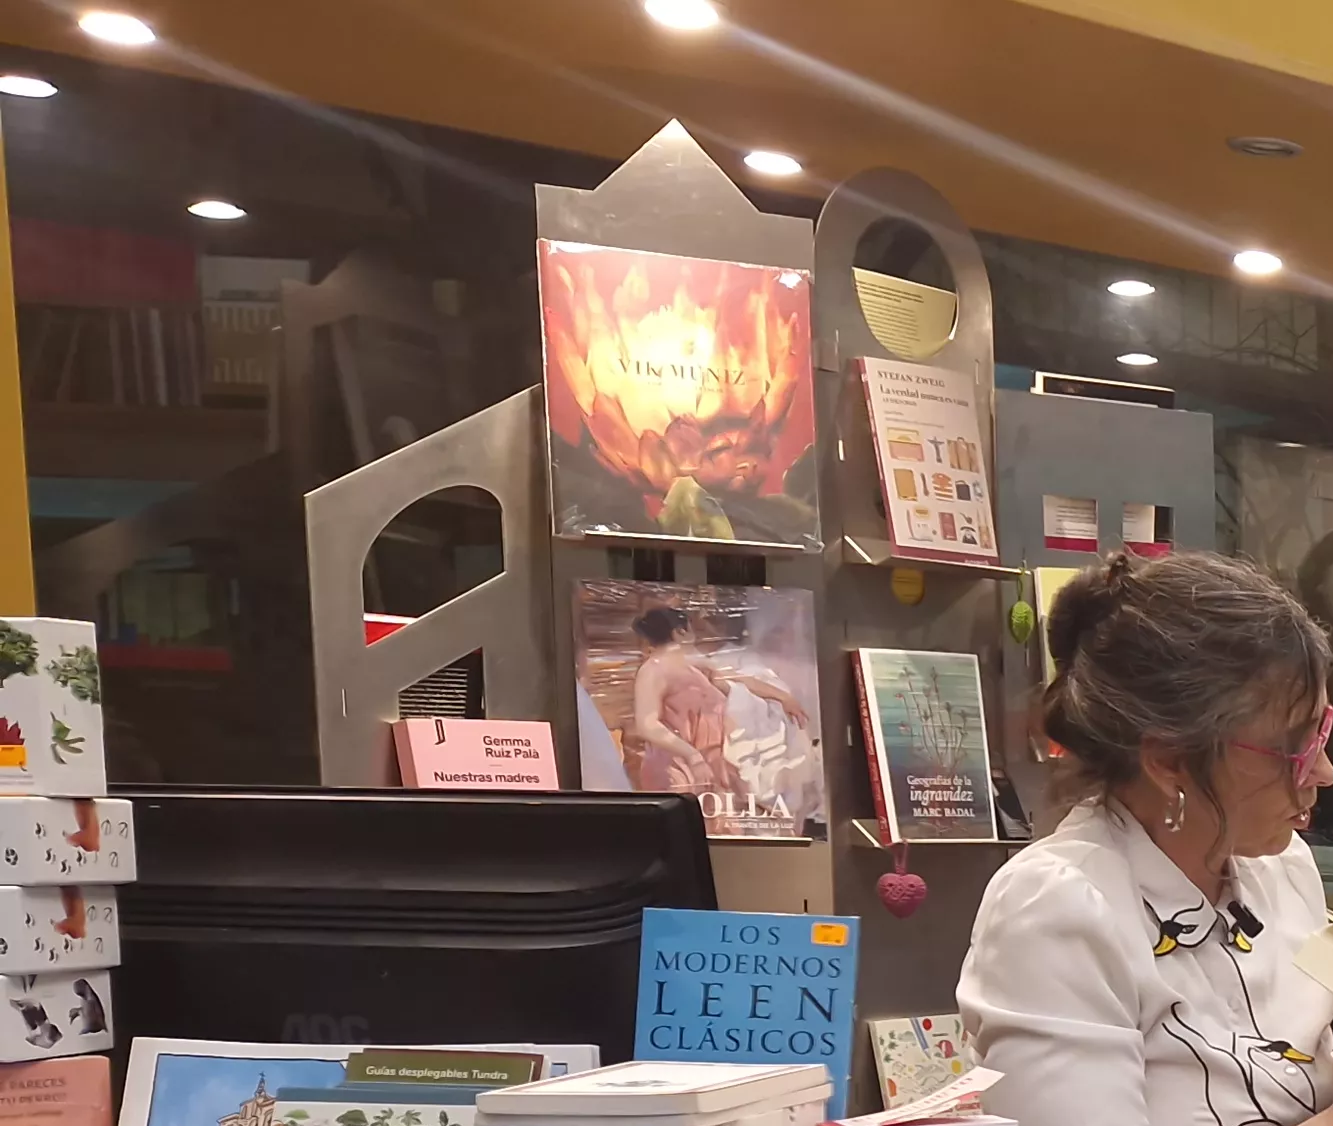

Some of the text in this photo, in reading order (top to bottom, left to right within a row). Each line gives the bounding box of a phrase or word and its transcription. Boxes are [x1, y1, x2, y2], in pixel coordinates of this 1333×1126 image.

[483, 735, 531, 747] Gemma
[485, 747, 540, 760] Ruiz Palà
[434, 771, 540, 784] Nuestras madres
[953, 775, 963, 786] de
[910, 785, 974, 806] ingravidez
[913, 807, 942, 817] MARC
[720, 923, 782, 947] LOS
[654, 950, 843, 980] MODERNOS
[652, 979, 839, 1023] LEEN
[649, 1023, 837, 1057] CLÁSICOS
[365, 1064, 509, 1081] Guías desplegables Tundra
